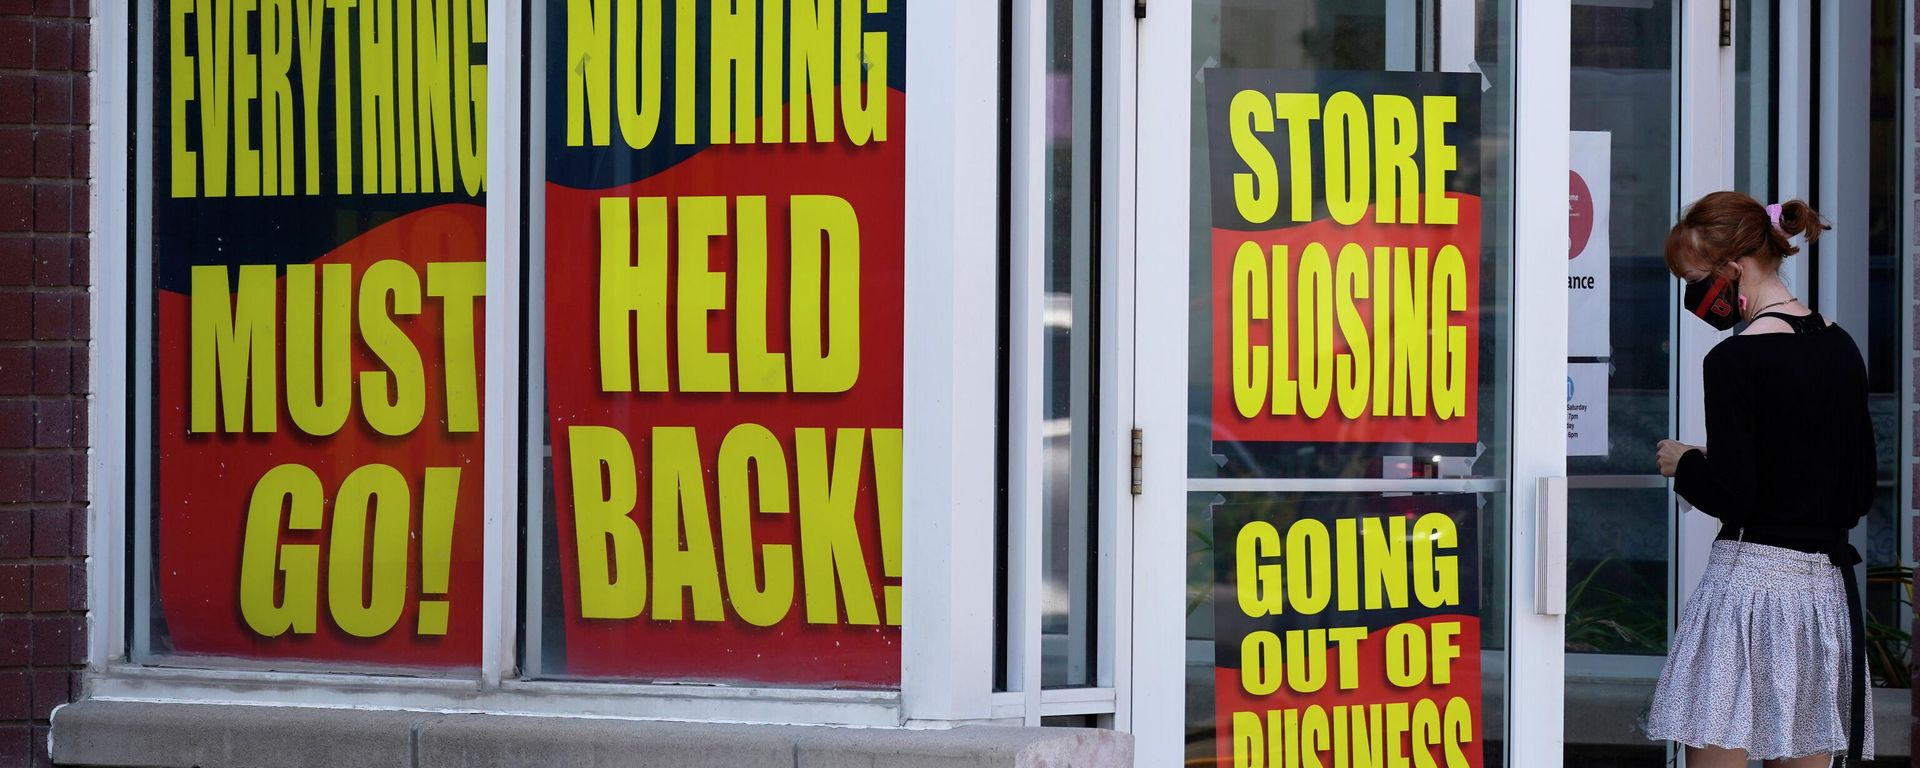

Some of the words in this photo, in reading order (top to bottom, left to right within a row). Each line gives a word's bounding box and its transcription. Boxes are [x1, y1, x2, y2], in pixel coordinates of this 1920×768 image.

[171, 0, 488, 197] EVERYTHING
[568, 0, 889, 148] NOTHING
[1230, 90, 1459, 225] STORE
[191, 259, 486, 436] MUST
[599, 195, 860, 393] HELD
[1232, 241, 1467, 420] CLOSING
[240, 463, 461, 637] GO!
[568, 424, 902, 627] BACK!
[1235, 512, 1460, 618] GOING
[1240, 626, 1368, 696] OUT
[1385, 621, 1461, 688] OF
